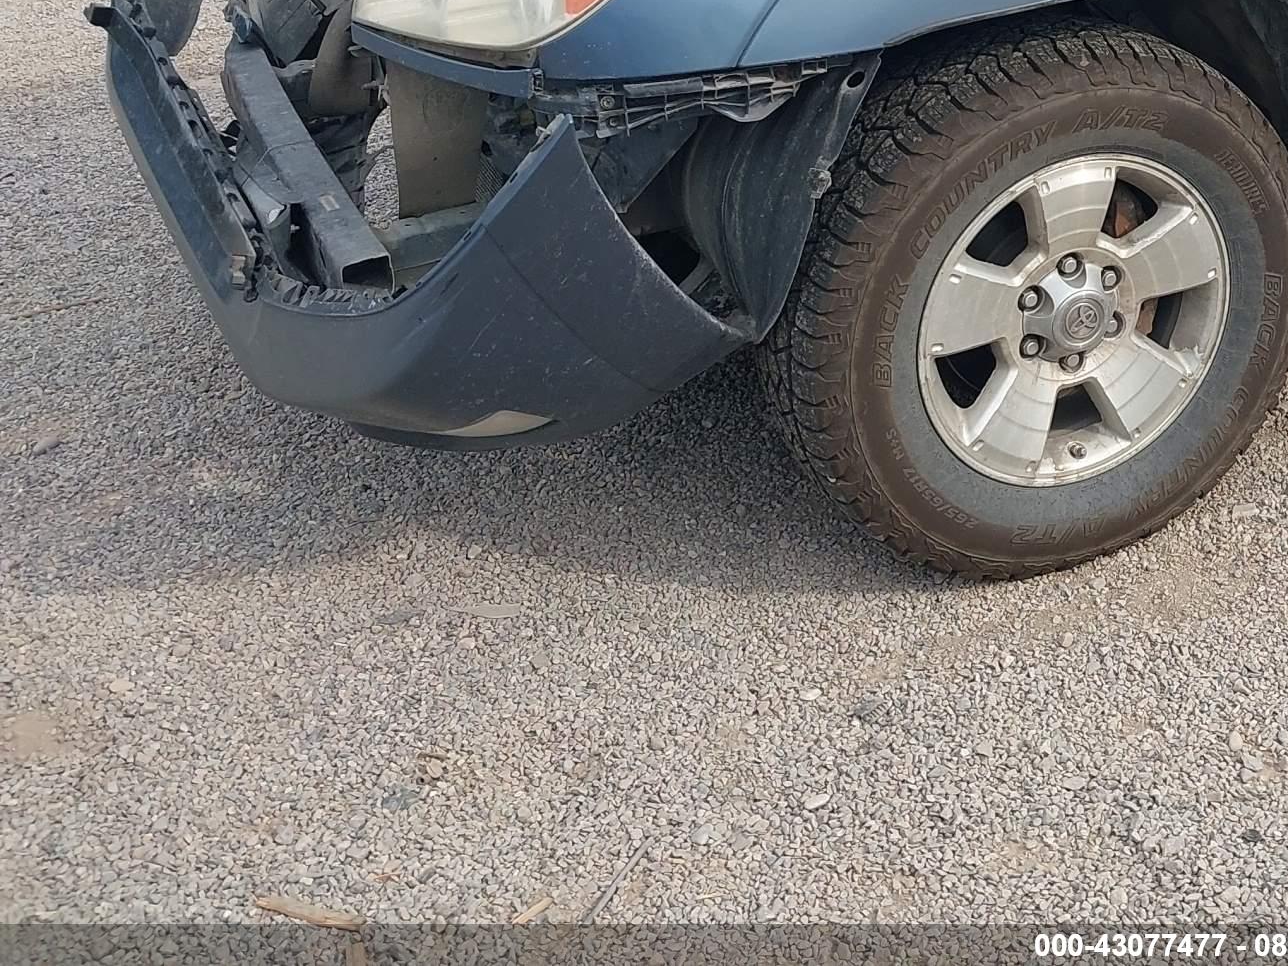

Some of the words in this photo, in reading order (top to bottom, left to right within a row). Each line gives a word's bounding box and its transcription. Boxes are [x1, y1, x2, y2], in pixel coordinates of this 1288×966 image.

[872, 274, 910, 389] BACK
[909, 120, 1058, 261] COUNTRY
[1070, 105, 1171, 135] A/T2
[1248, 272, 1283, 374] BACK
